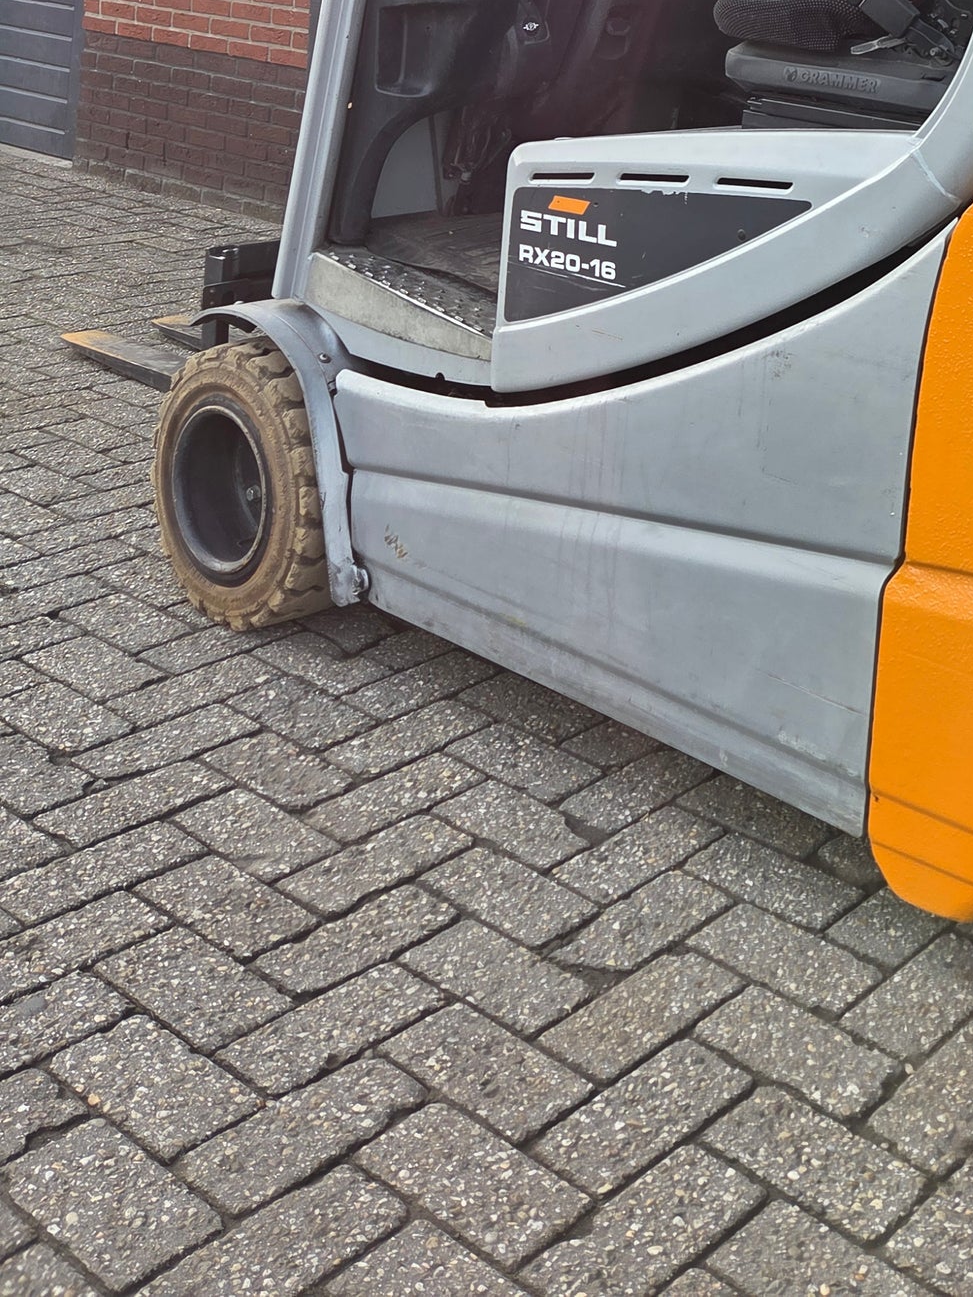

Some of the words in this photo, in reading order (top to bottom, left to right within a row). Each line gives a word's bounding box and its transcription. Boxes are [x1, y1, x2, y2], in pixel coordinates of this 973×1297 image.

[801, 69, 880, 95] GRAMMER
[520, 209, 618, 248] STILL
[519, 243, 617, 281] RX20-16
